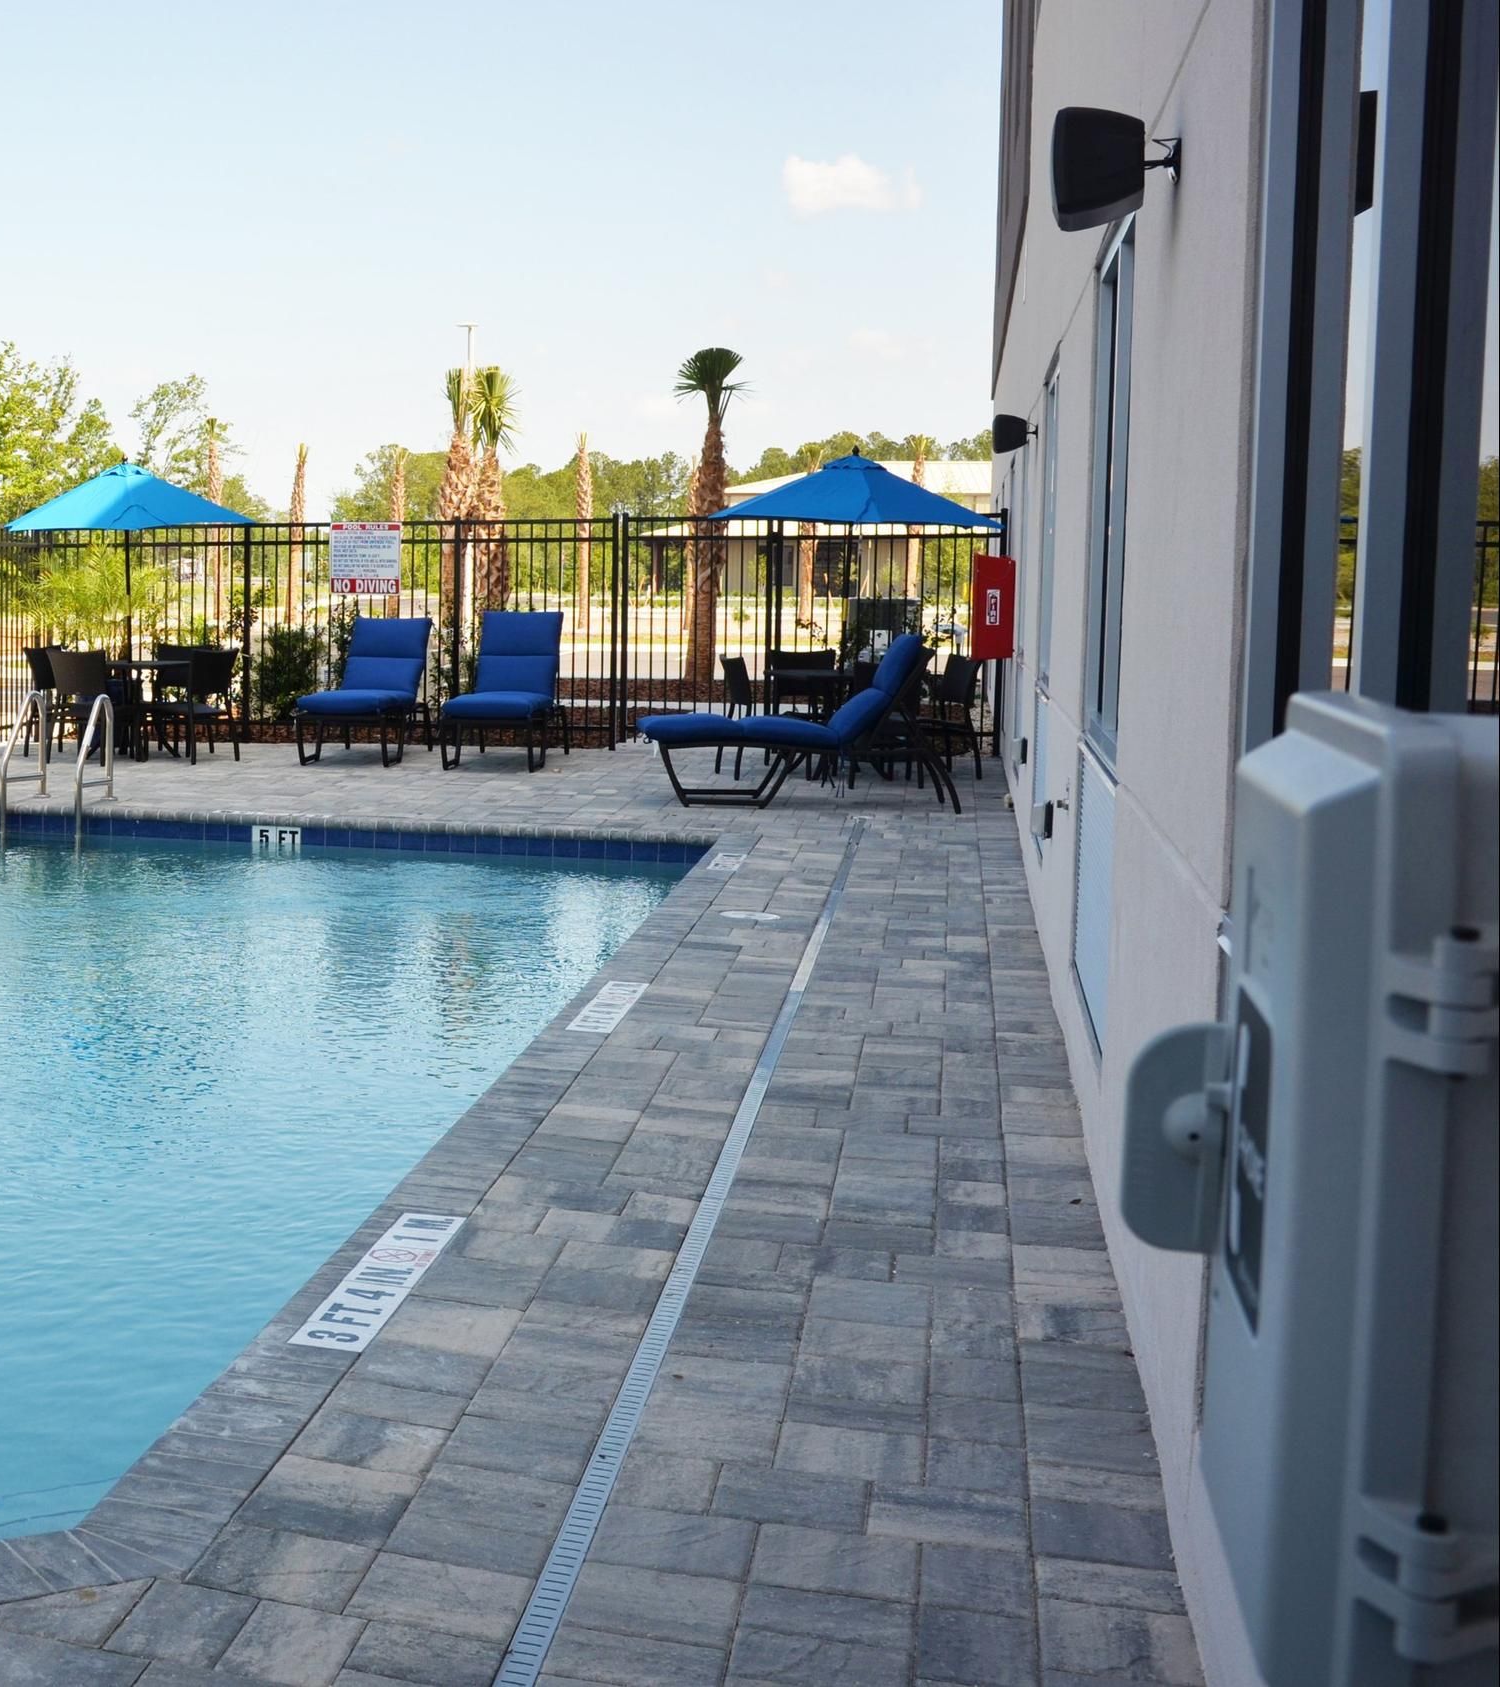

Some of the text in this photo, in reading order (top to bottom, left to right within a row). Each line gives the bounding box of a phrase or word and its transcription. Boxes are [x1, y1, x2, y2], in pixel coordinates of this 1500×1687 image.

[333, 579, 396, 593] NO DIVING
[259, 829, 299, 844] 5 FT
[402, 1217, 456, 1232] M.
[393, 1234, 439, 1242] 1
[355, 1265, 415, 1285] IN.
[344, 1287, 397, 1301] 4
[319, 1302, 384, 1328] FT.
[307, 1329, 360, 1343] 3
